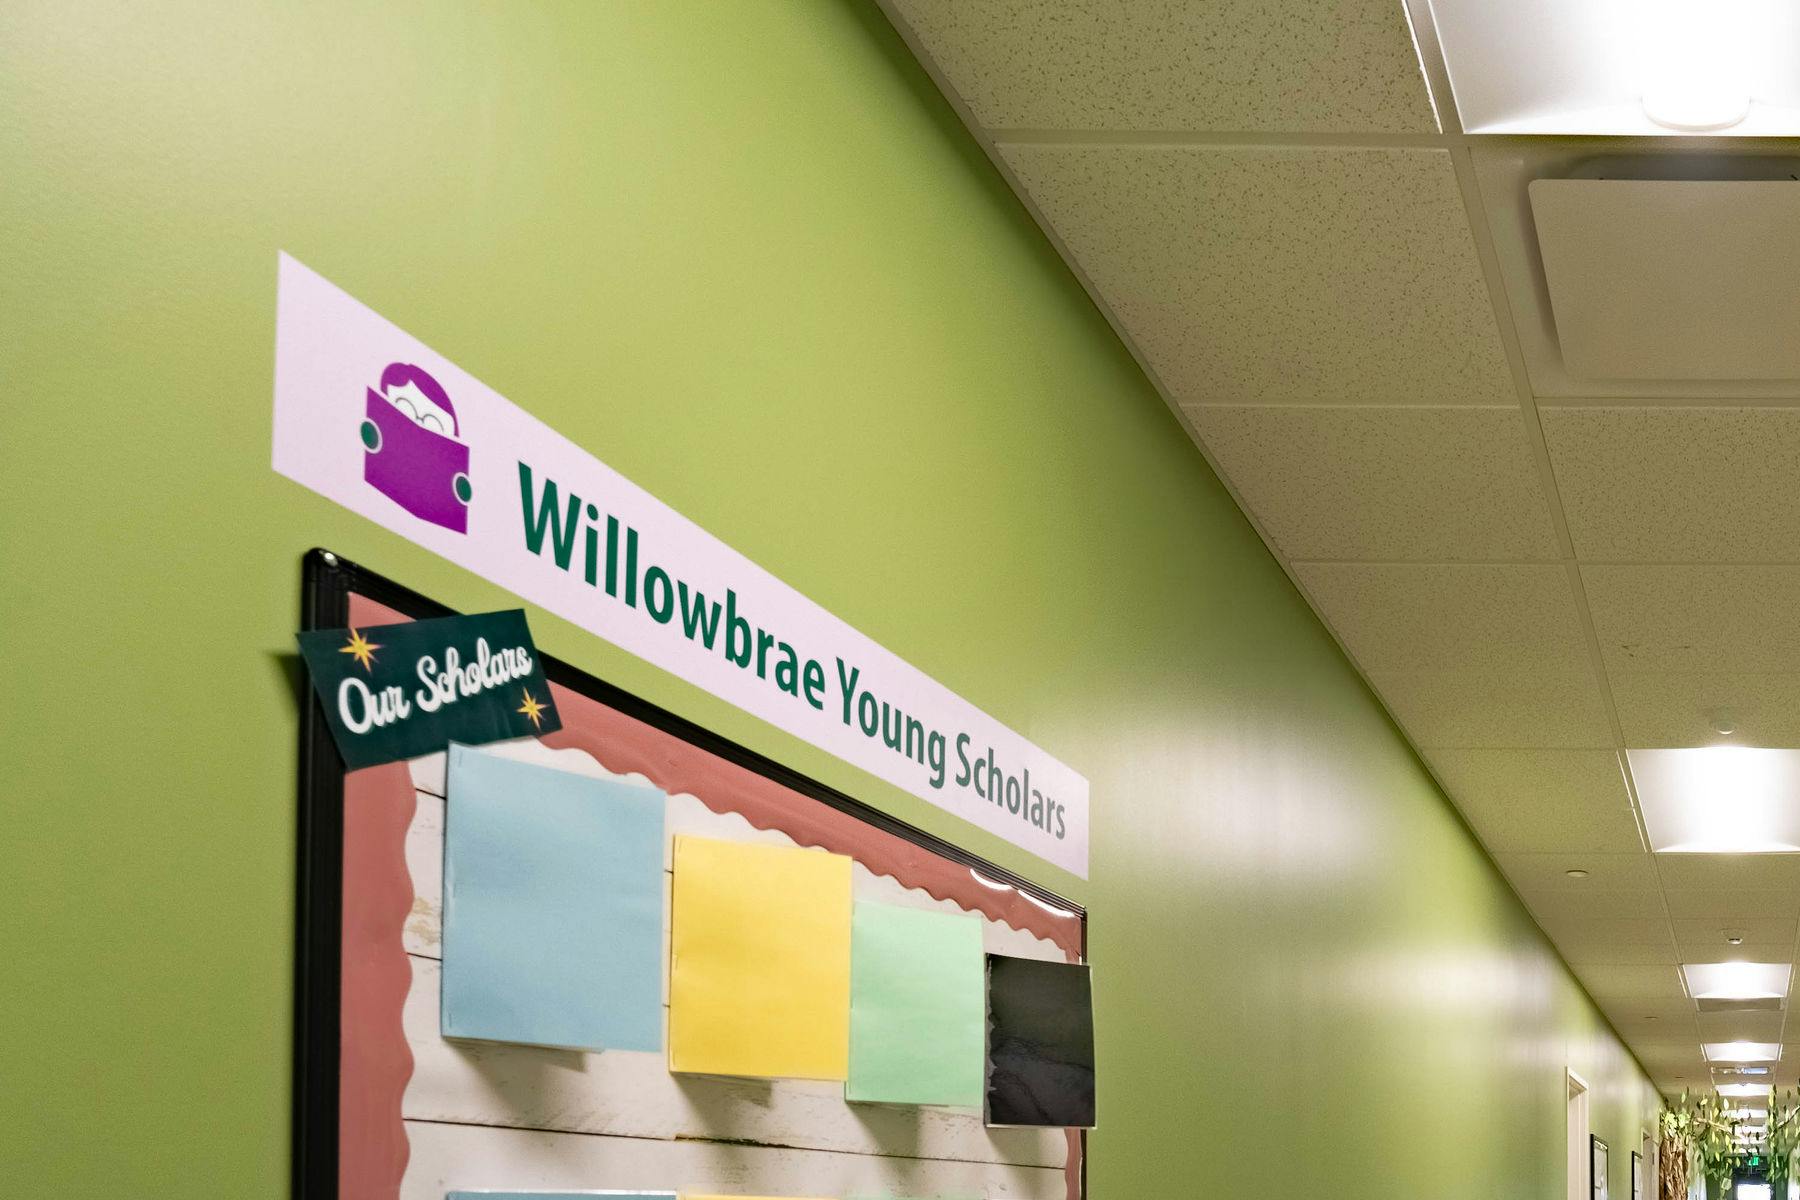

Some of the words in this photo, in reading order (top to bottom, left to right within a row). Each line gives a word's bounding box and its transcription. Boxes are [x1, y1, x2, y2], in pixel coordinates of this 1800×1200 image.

[338, 677, 410, 734] Our
[416, 637, 533, 712] Scholars
[518, 460, 825, 711] Willowbrae
[836, 656, 946, 790] Young
[955, 732, 1066, 841] Scholars
